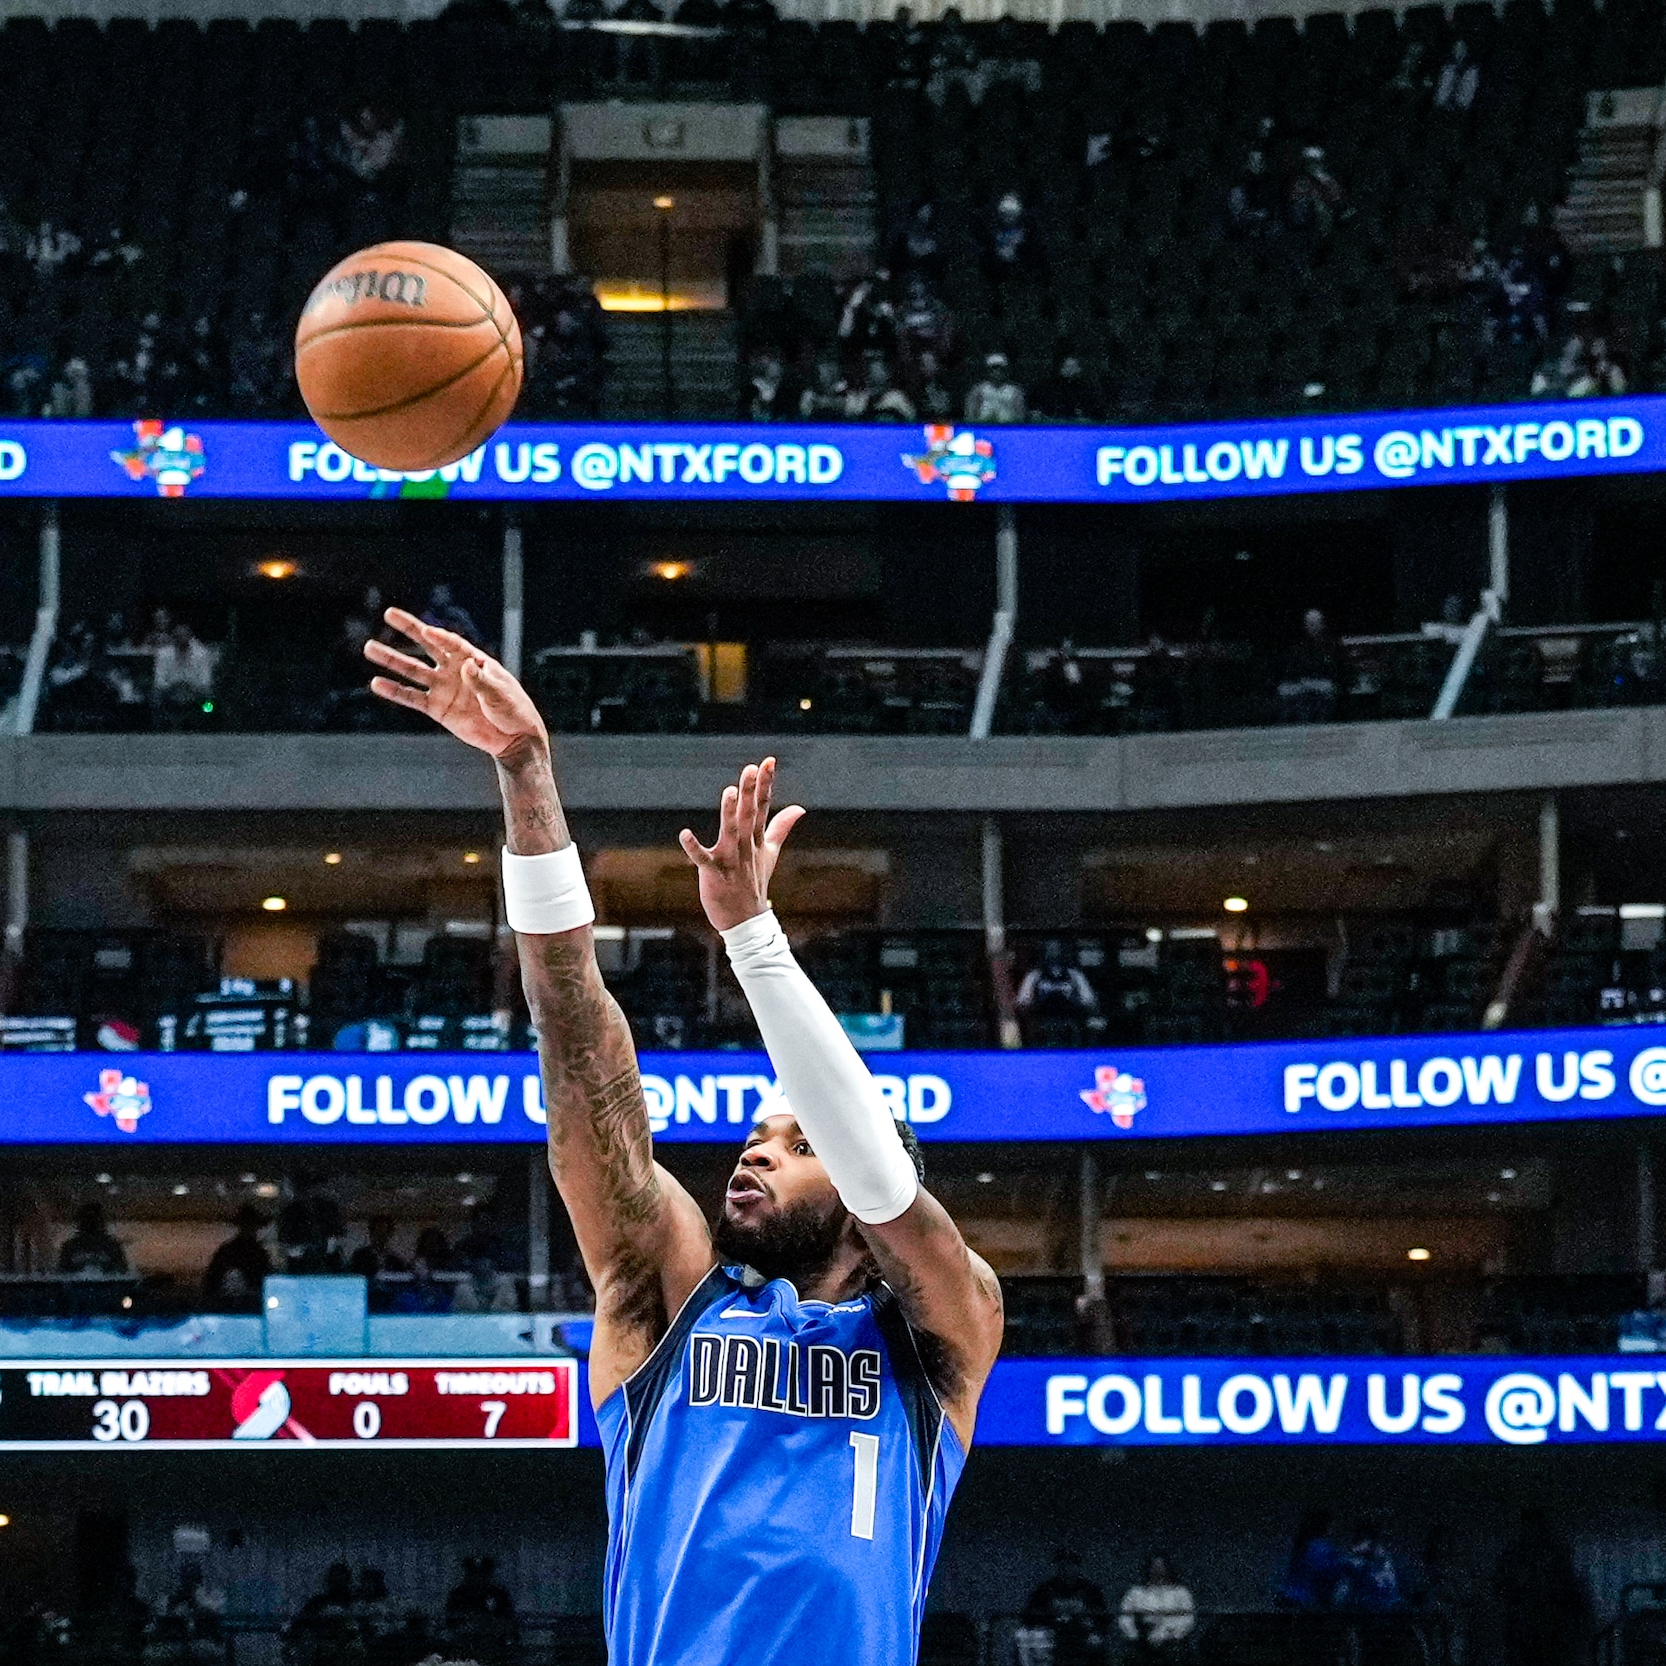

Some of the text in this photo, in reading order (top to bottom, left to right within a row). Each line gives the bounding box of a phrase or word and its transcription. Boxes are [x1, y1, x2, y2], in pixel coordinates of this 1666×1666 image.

[289, 442, 842, 489] FOLW US @NTXFORD
[1097, 419, 1642, 485] FOLLOW US @NTXFORD
[268, 1075, 509, 1124] FOLLOW
[634, 1074, 951, 1133] @NTXRD
[1285, 1055, 1521, 1112] FOLLOW
[1537, 1051, 1615, 1101] US
[27, 1371, 211, 1396] TRAIL BLAZERS
[329, 1372, 556, 1396] FOULS TIMEOUTS
[689, 1333, 880, 1420] DALLAS
[1047, 1375, 1347, 1434] FOLLOW
[1368, 1374, 1464, 1432] US
[93, 1400, 149, 1441] 30
[353, 1401, 507, 1439] 0 7
[849, 1431, 879, 1541] 1
